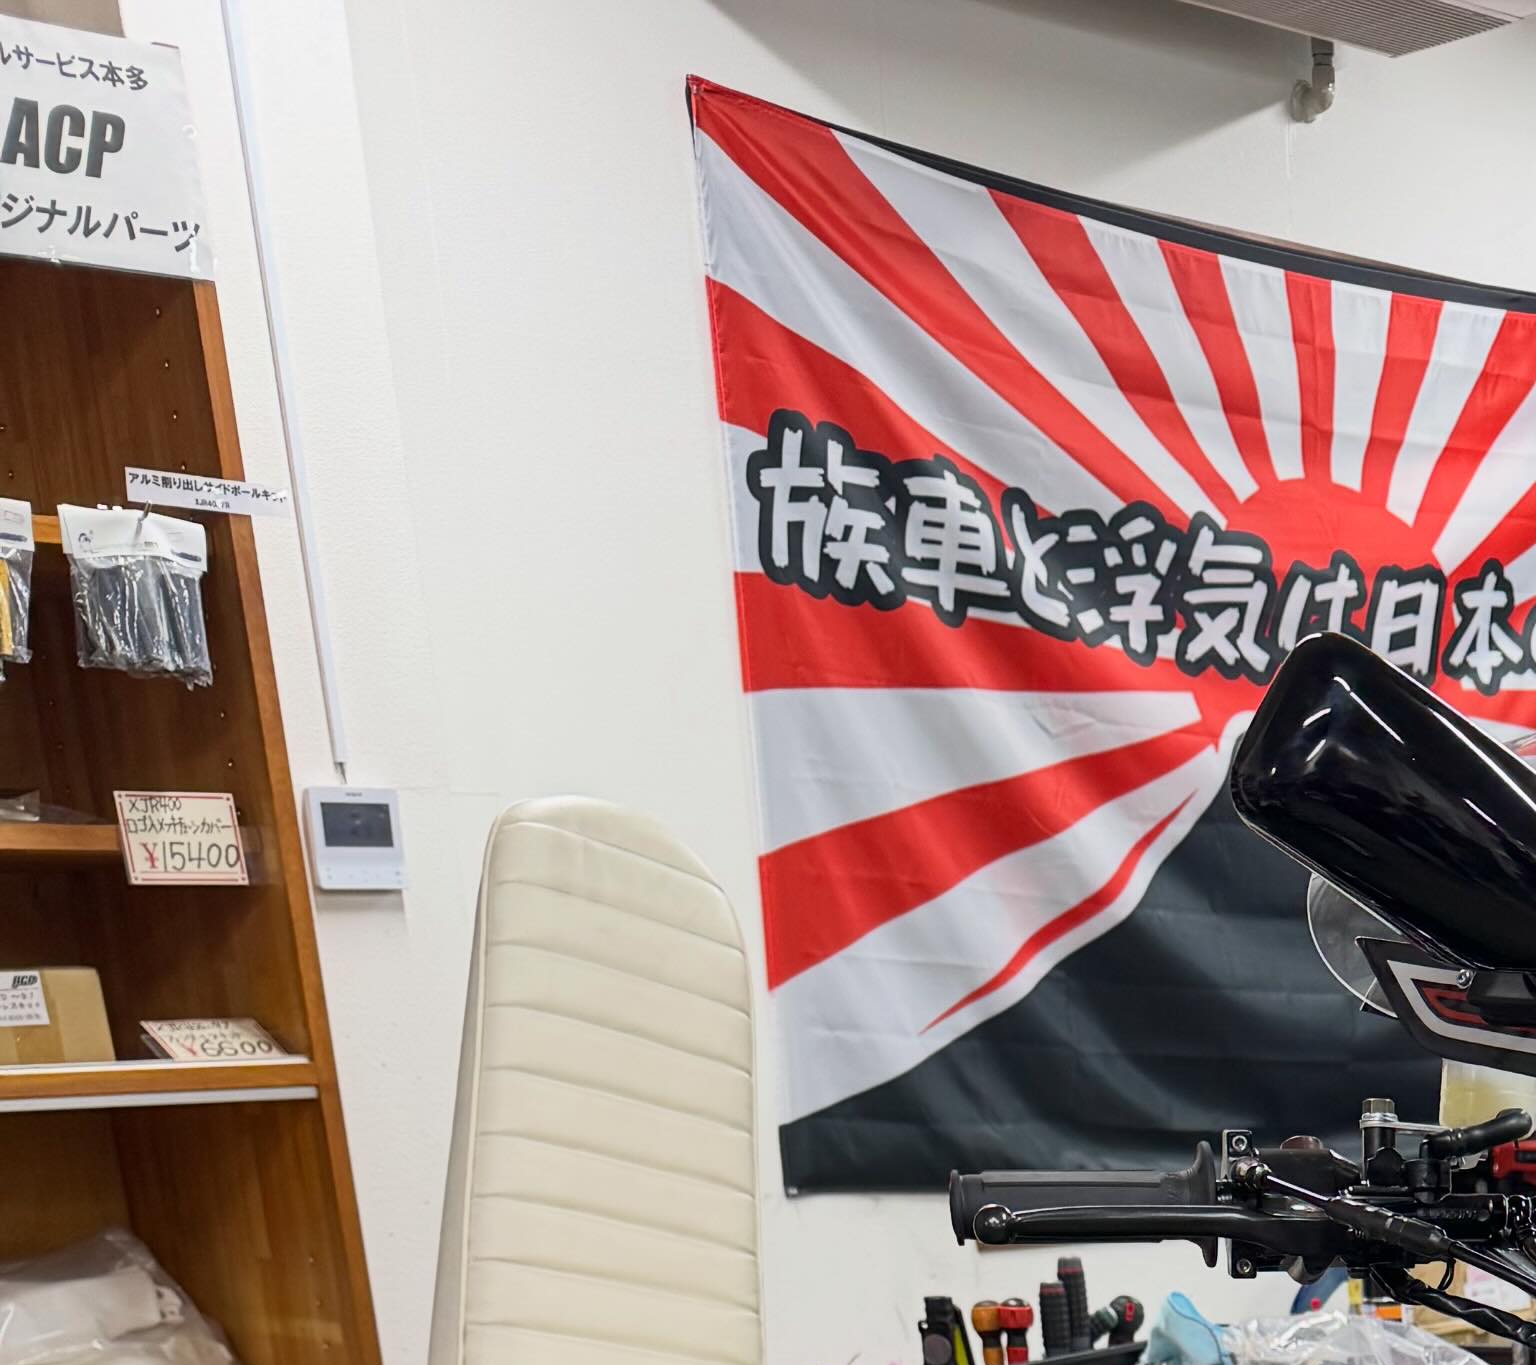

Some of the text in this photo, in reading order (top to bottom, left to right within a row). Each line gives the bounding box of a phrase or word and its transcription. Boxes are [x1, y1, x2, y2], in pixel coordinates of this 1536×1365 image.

[0, 97, 126, 178] ACP
[1, 193, 200, 252] ジナルパーツ
[128, 797, 182, 813] XJR400
[140, 841, 240, 871] ¥15400
